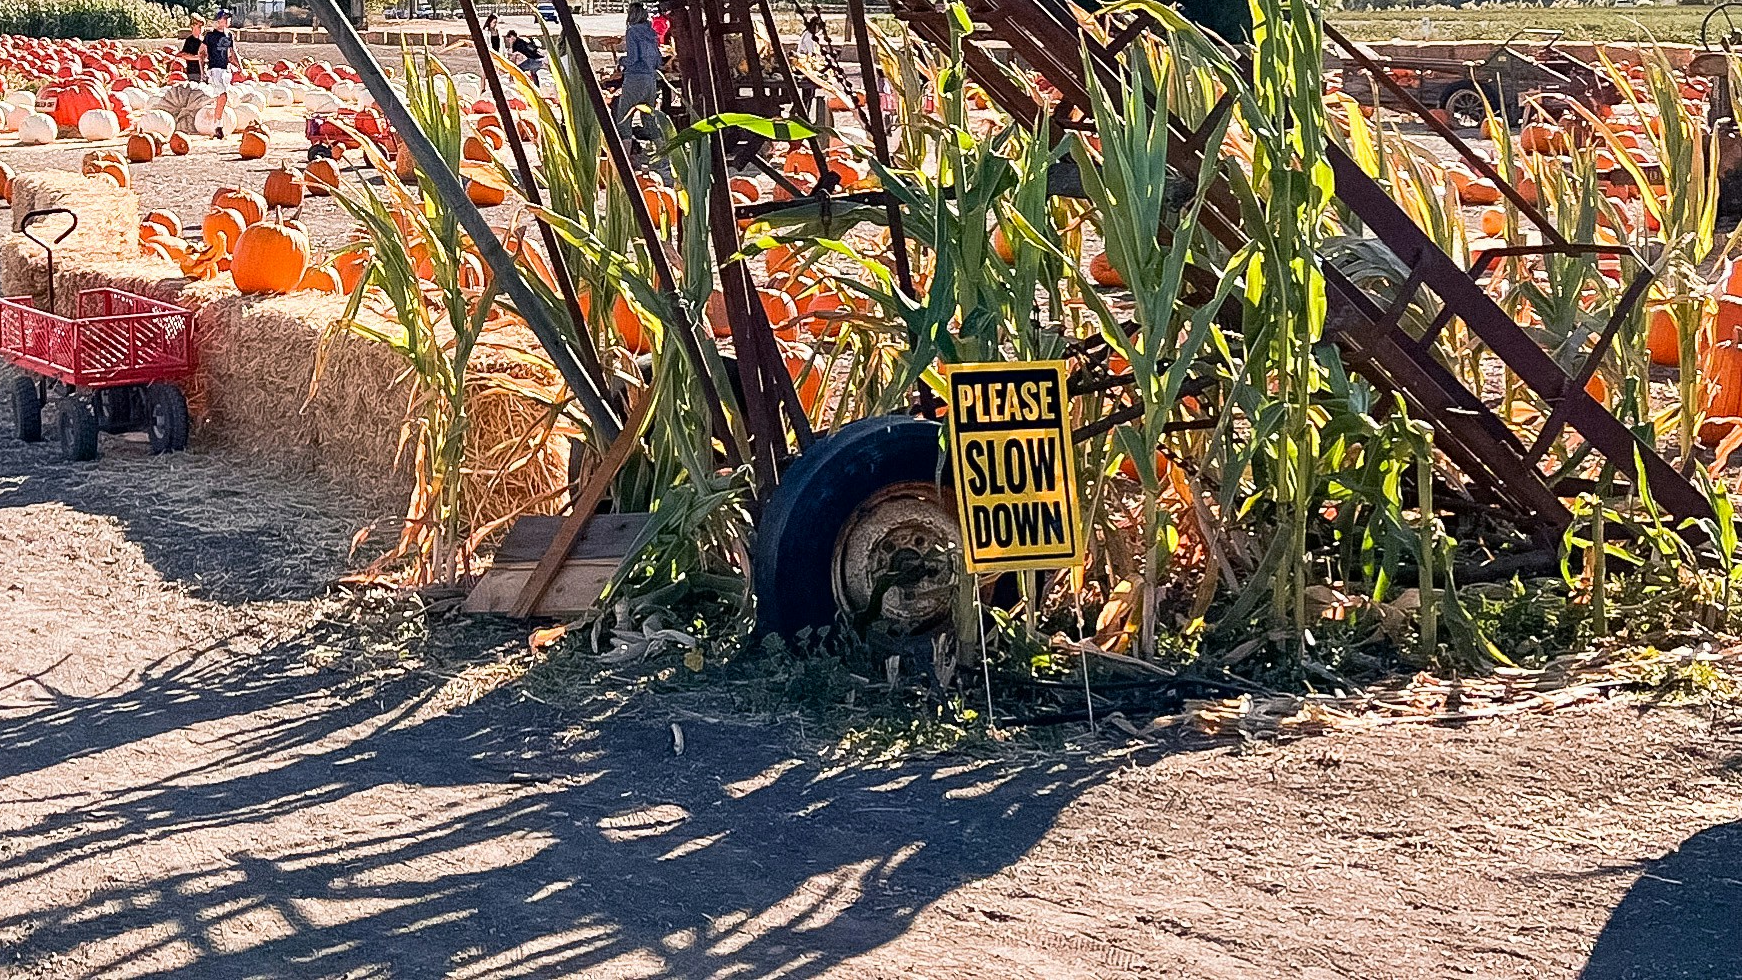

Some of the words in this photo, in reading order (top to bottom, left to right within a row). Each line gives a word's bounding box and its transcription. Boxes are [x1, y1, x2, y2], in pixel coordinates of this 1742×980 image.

[958, 381, 1055, 423] PLEASE
[965, 437, 1056, 497] SLOW
[973, 501, 1064, 550] DOWN
